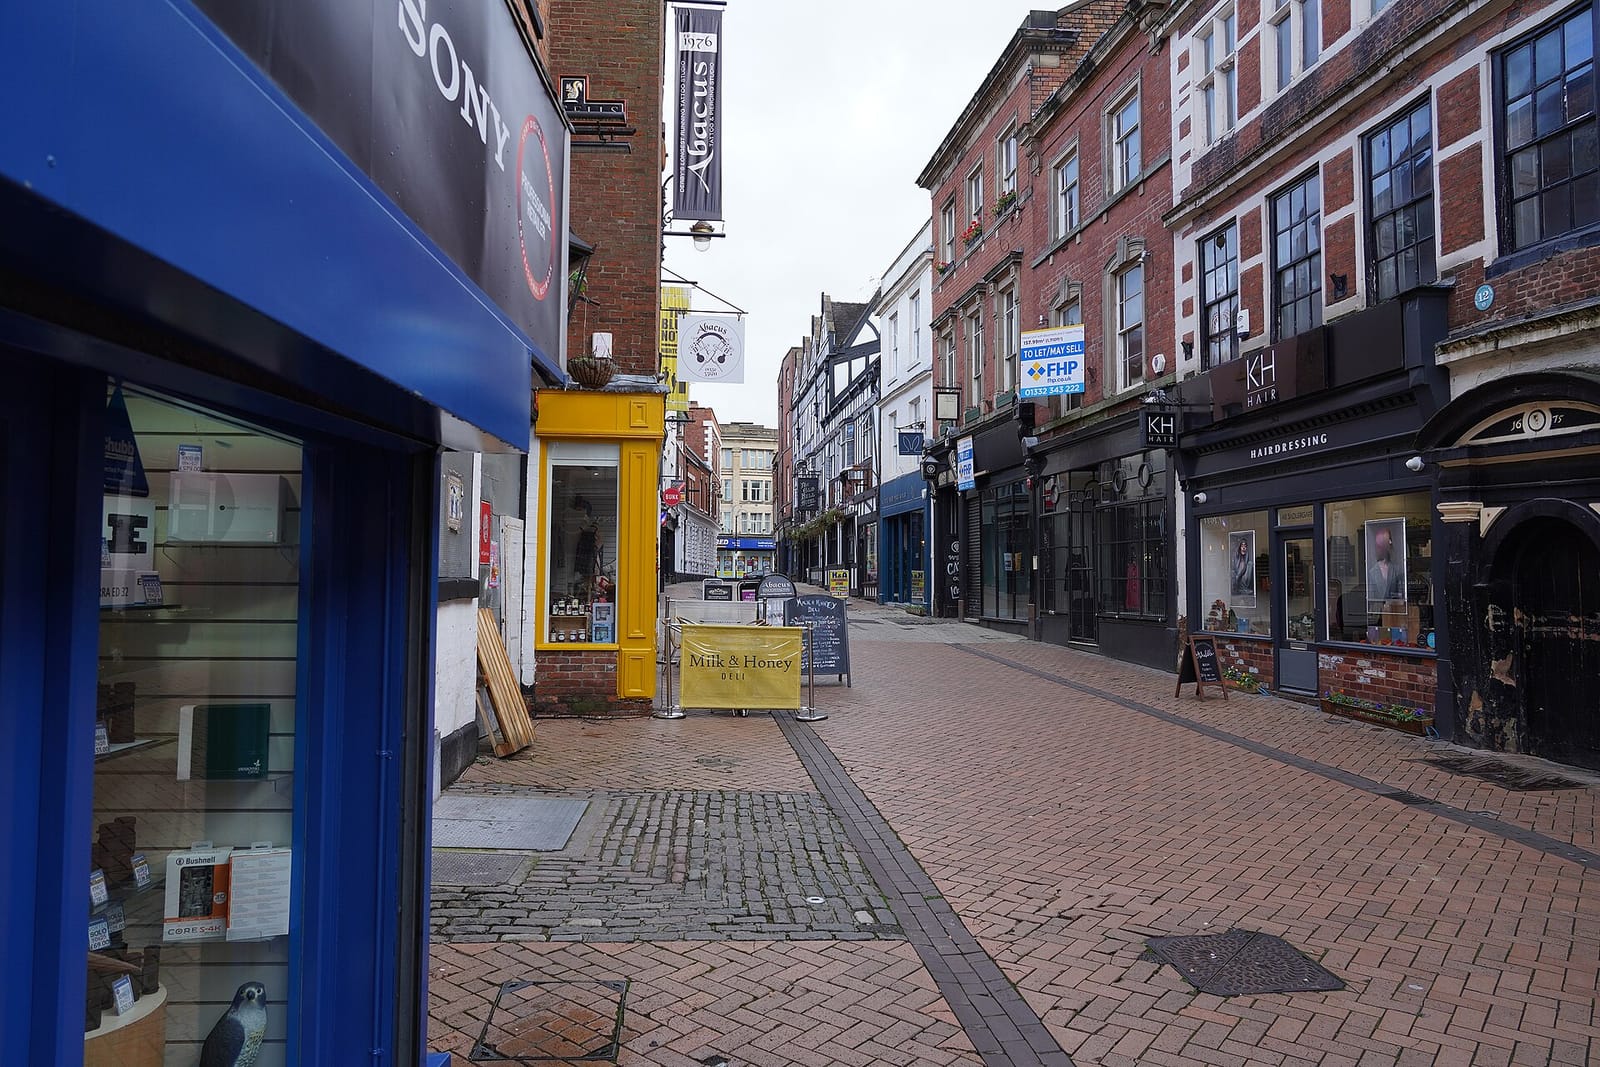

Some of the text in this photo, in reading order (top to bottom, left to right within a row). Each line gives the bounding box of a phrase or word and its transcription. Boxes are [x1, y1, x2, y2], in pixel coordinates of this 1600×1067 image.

[683, 34, 713, 49] 1976
[398, 0, 511, 172] SONY
[686, 61, 715, 194] Abacus
[1478, 291, 1489, 302] 12
[697, 322, 728, 334] Abacus
[1023, 344, 1082, 358] TO LET/MAY SELL
[1047, 361, 1078, 377] FHP
[1246, 350, 1275, 390] KH
[1047, 375, 1072, 383] fhp.co.uk
[1025, 384, 1080, 396] 01332 343 222
[1247, 389, 1276, 408] HAIR
[1148, 416, 1174, 435] KH
[1552, 414, 1565, 424] 75
[1148, 435, 1175, 443] HAIR
[1250, 433, 1328, 459] HAIRDRESSING
[689, 654, 793, 673] Milk & Honey
[721, 672, 746, 681] DELI
[185, 856, 216, 865] Bushnell
[89, 927, 107, 938] SOLO
[167, 926, 199, 936] CORE
